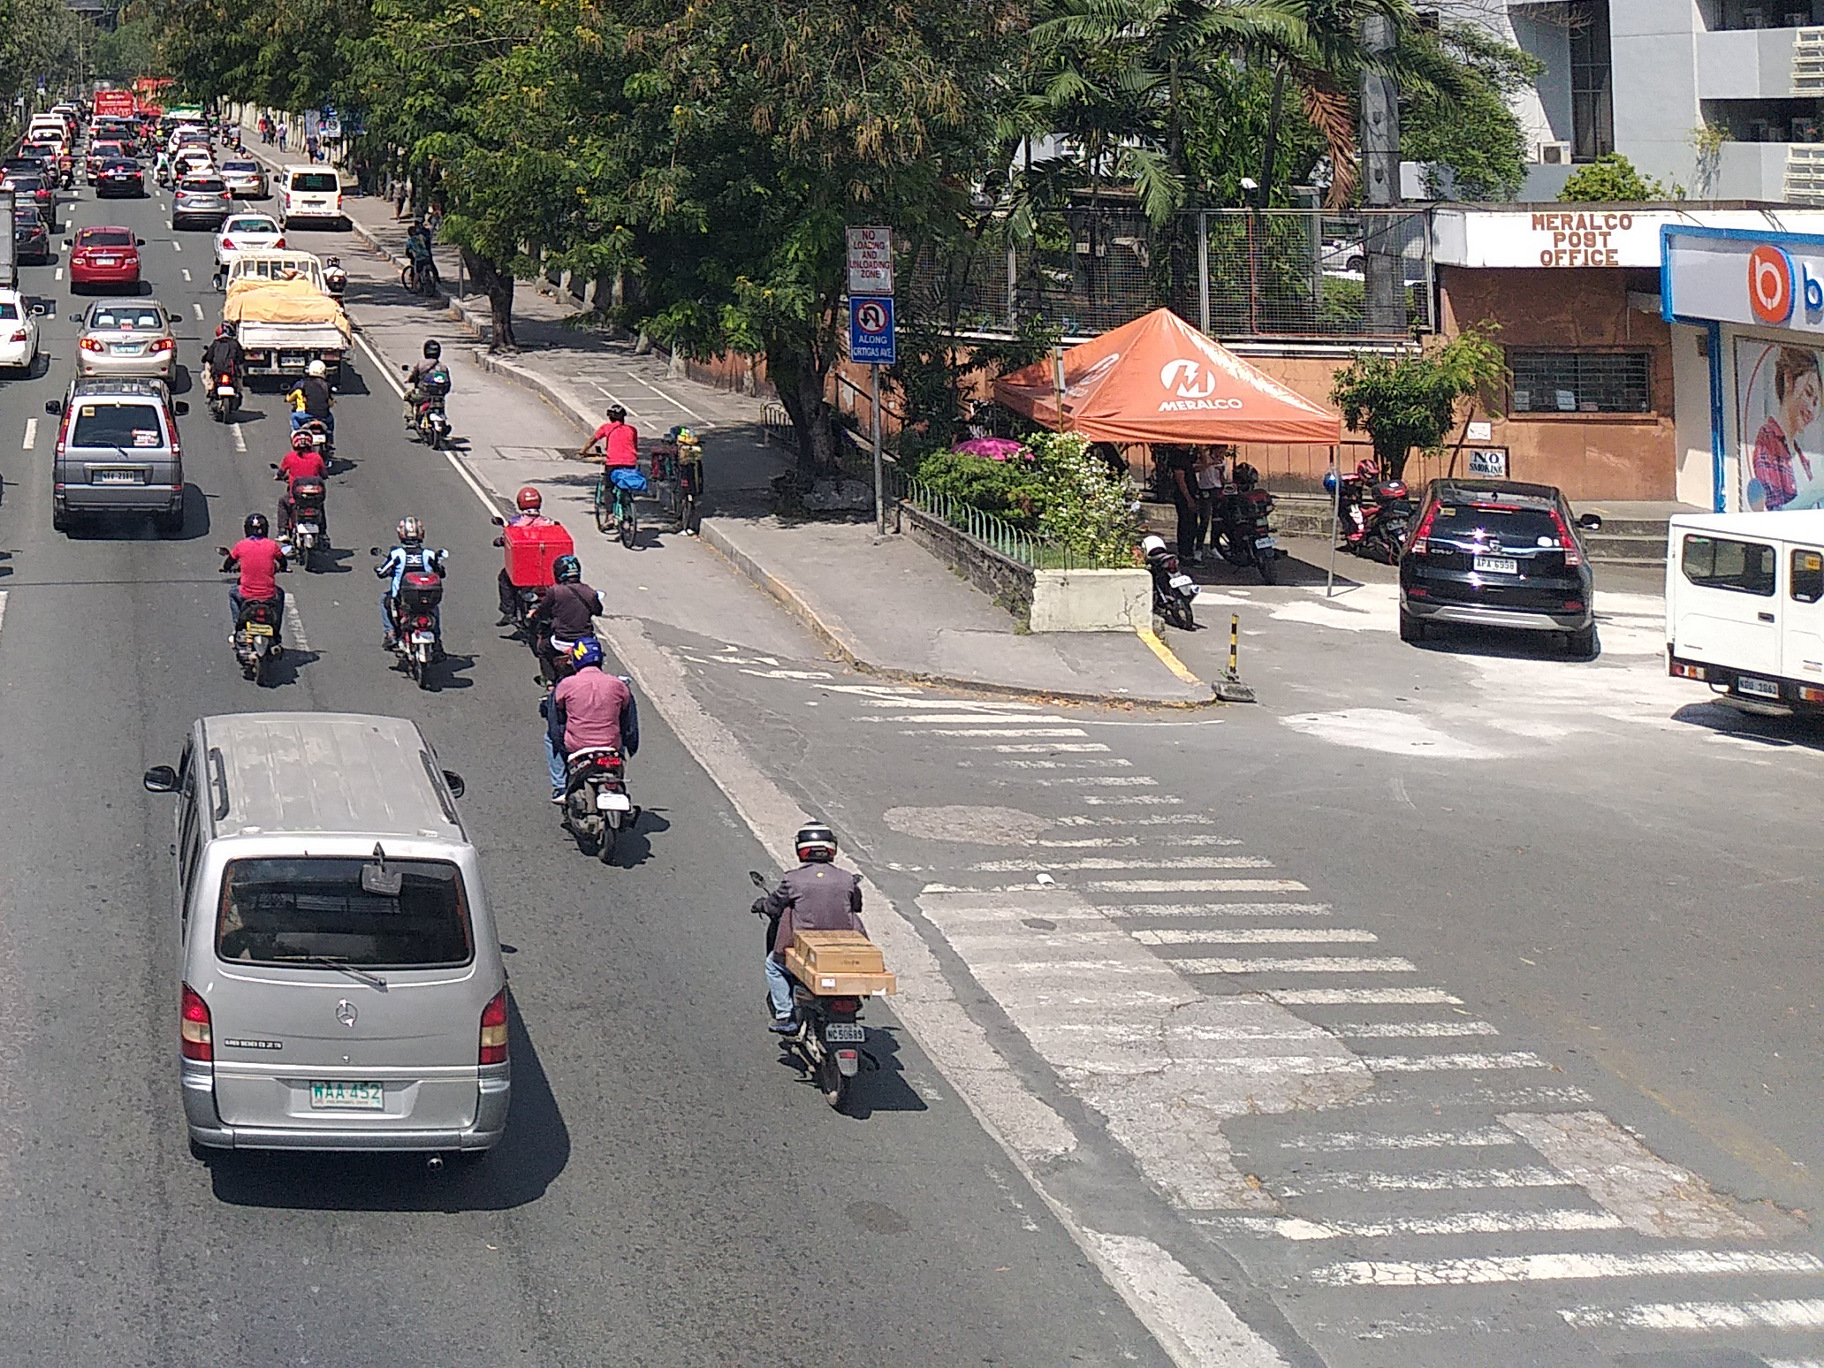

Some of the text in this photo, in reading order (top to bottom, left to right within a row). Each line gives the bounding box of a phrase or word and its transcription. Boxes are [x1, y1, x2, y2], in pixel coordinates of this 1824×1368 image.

[1532, 213, 1632, 231] MERALCO
[862, 231, 875, 240] NO
[1553, 231, 1612, 248] POST
[862, 251, 877, 259] AND
[1540, 249, 1618, 266] OFFICE
[859, 335, 887, 344] ALONG
[1158, 398, 1243, 412] MERALCO
[1474, 452, 1499, 463] NO
[1469, 463, 1503, 473] SMOKING
[573, 641, 588, 660] M
[314, 1083, 380, 1100] WAA 452
